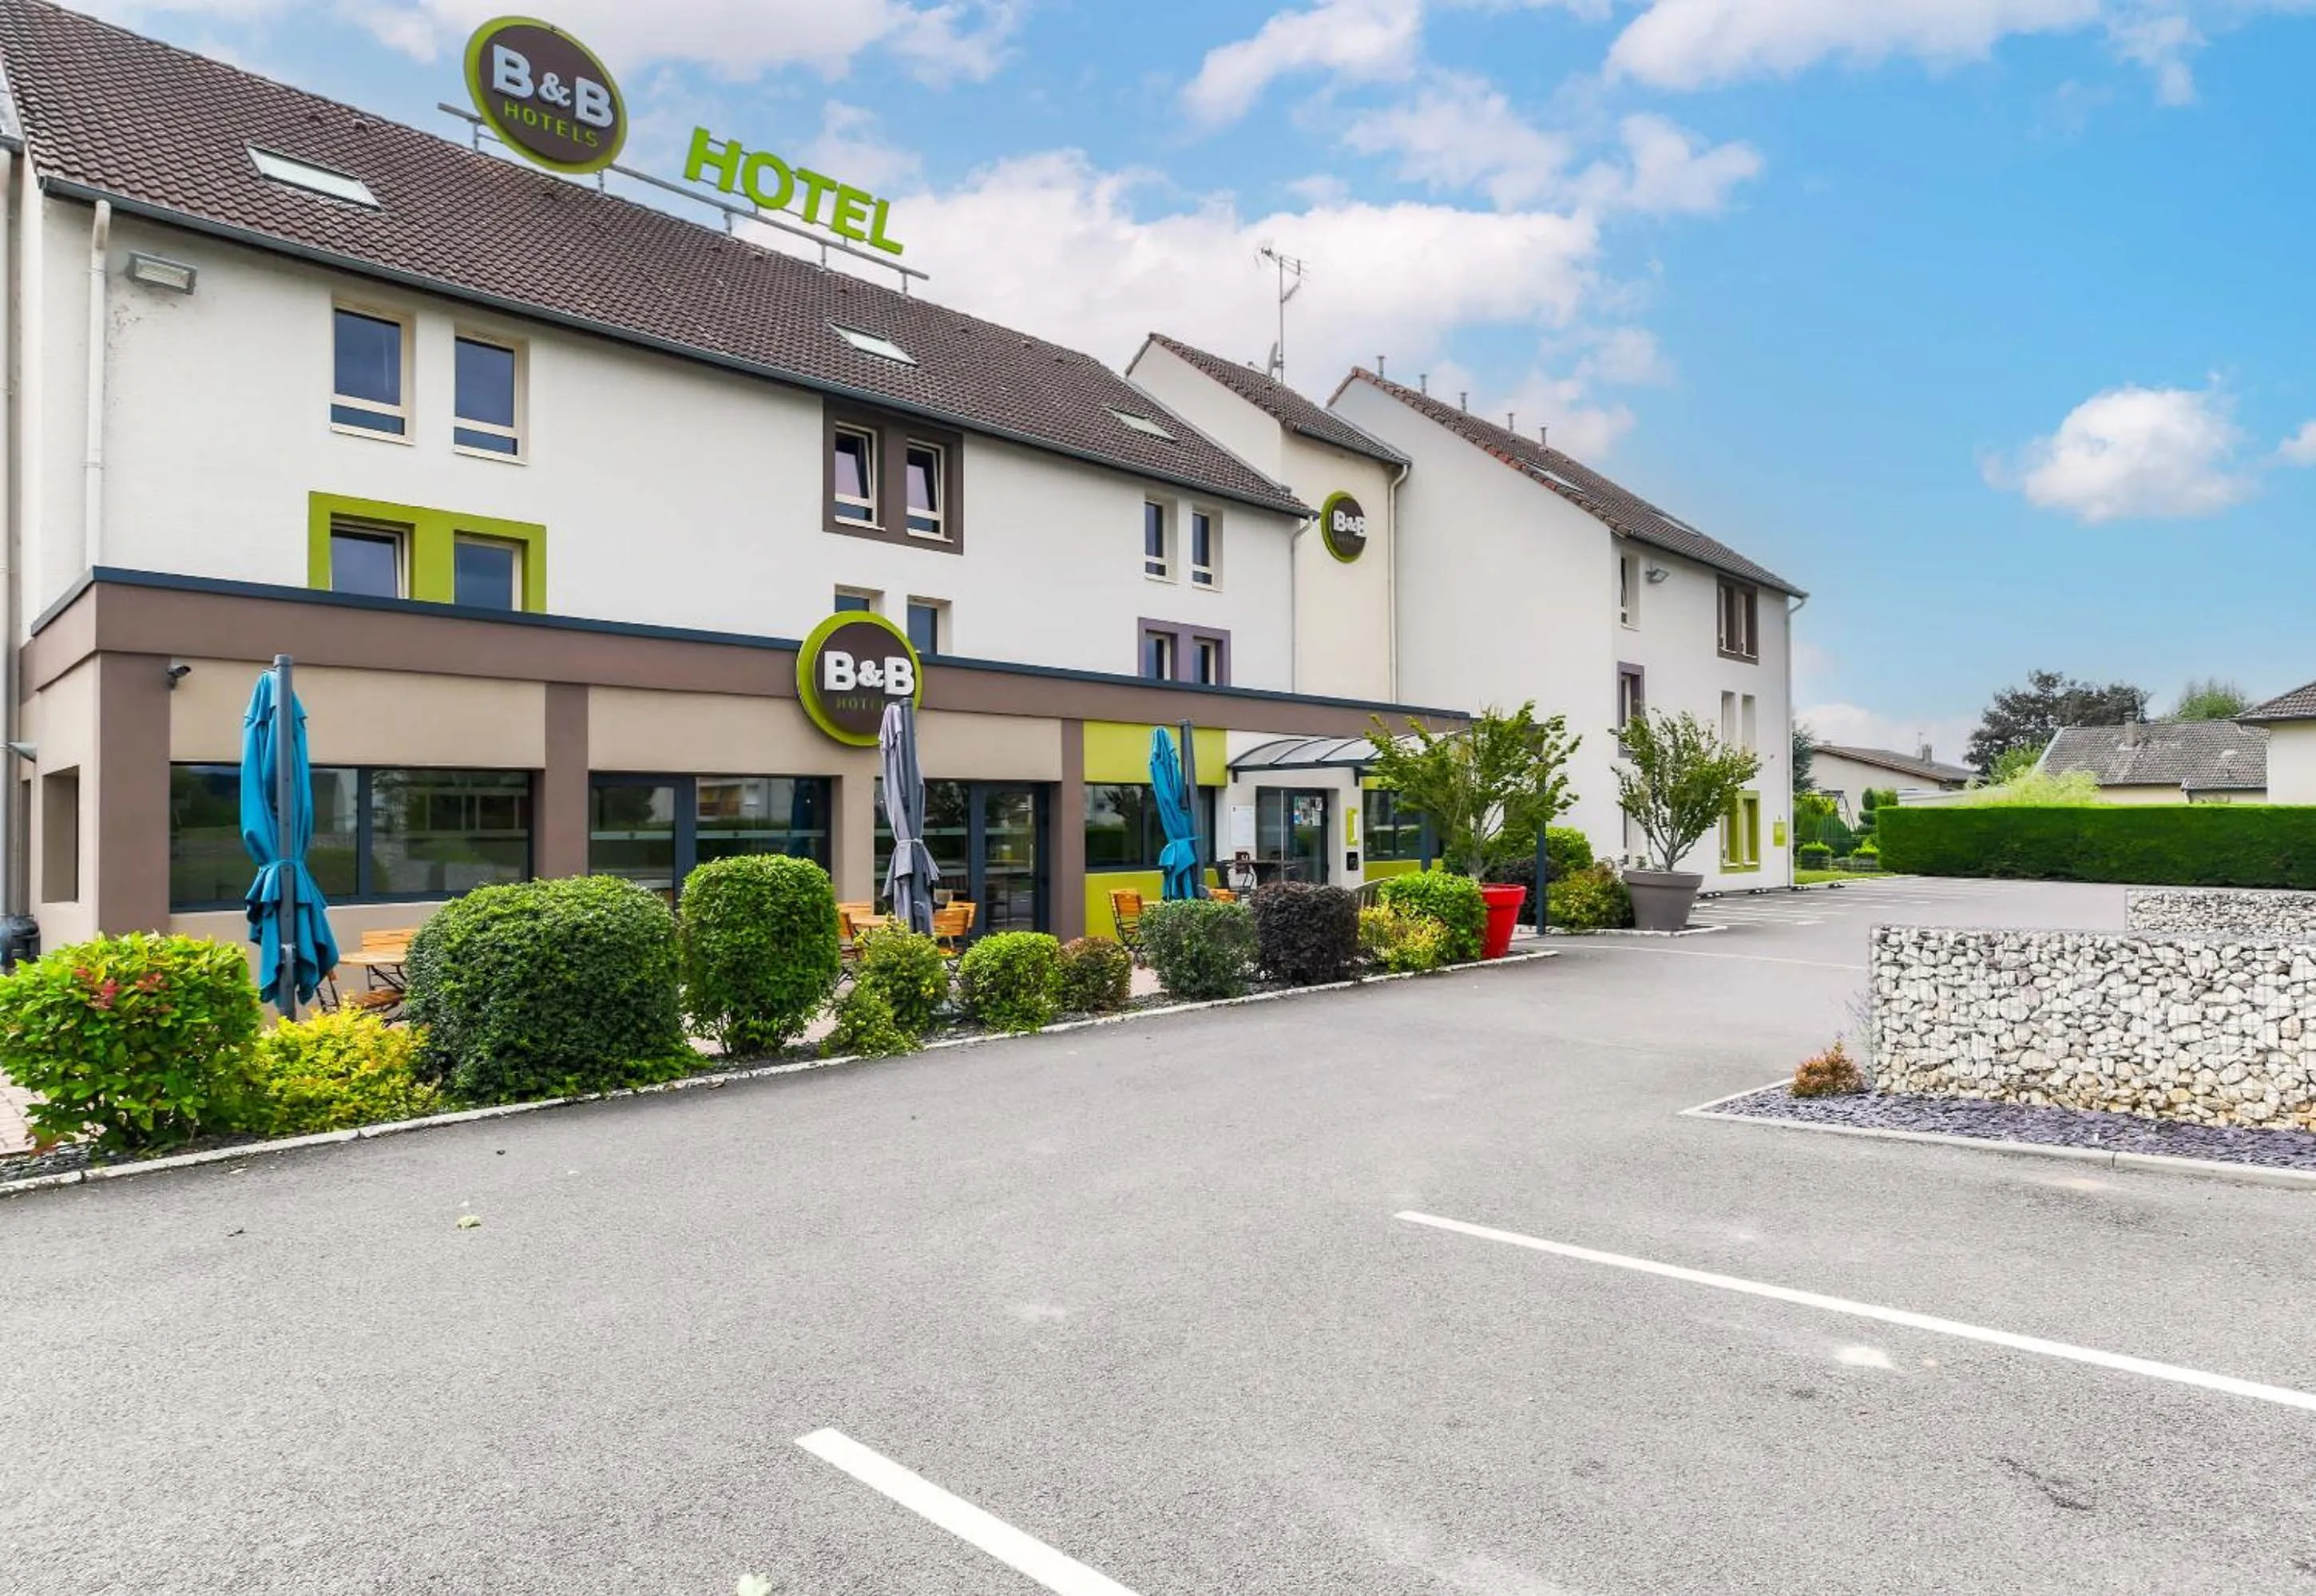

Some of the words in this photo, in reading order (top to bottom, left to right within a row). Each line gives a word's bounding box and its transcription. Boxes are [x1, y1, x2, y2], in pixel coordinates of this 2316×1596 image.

[493, 43, 614, 129] B&B
[503, 100, 599, 149] HOTELS
[683, 126, 904, 255] HOTEL
[1334, 509, 1366, 537] B&B
[824, 651, 915, 696] B&B
